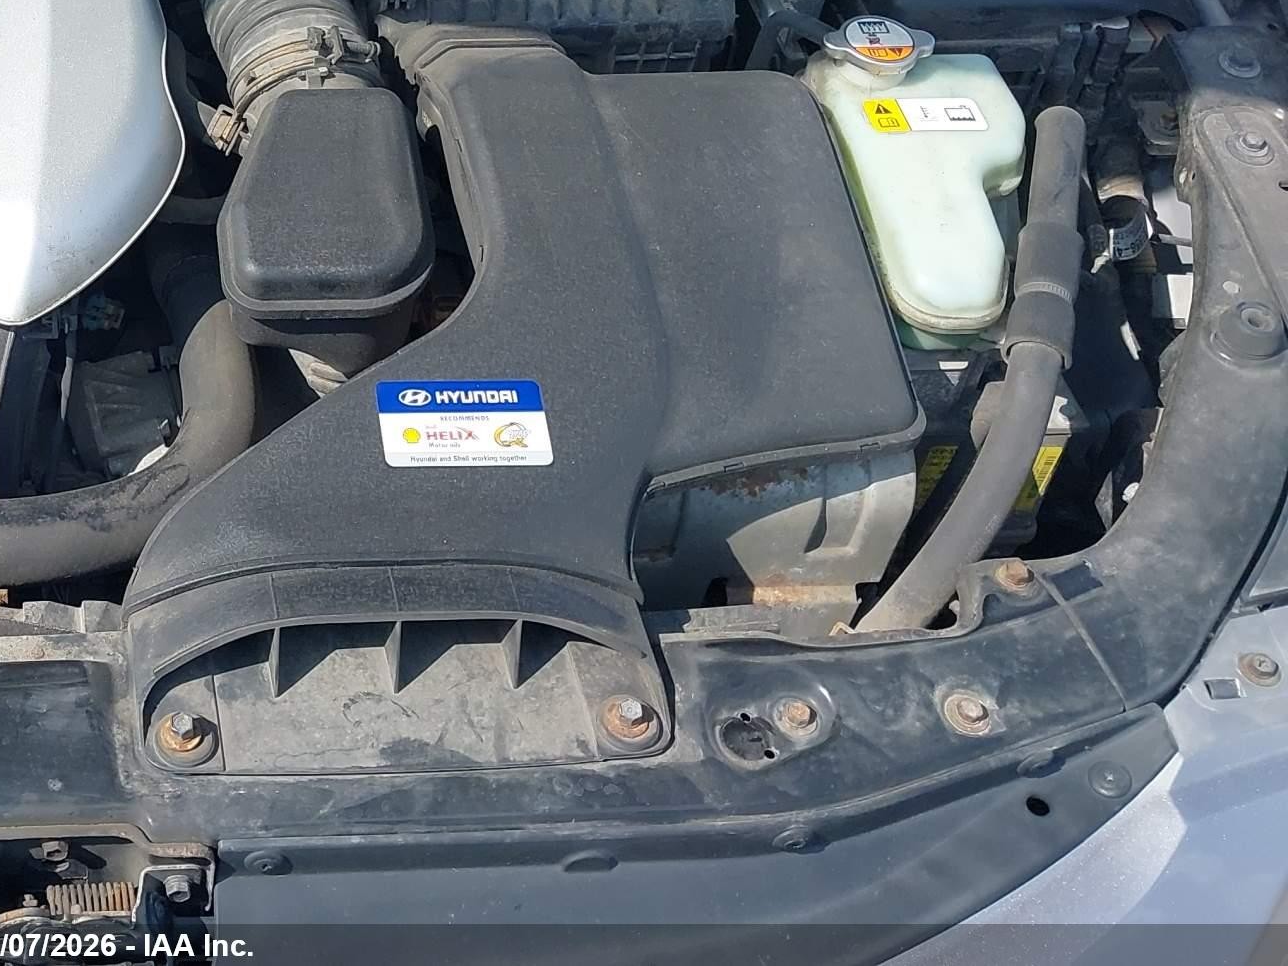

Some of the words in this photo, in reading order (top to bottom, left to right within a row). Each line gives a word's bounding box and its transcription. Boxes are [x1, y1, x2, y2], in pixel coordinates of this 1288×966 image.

[435, 390, 518, 404] HYUNDAI
[425, 430, 479, 441] HELIX
[472, 455, 498, 463] working
